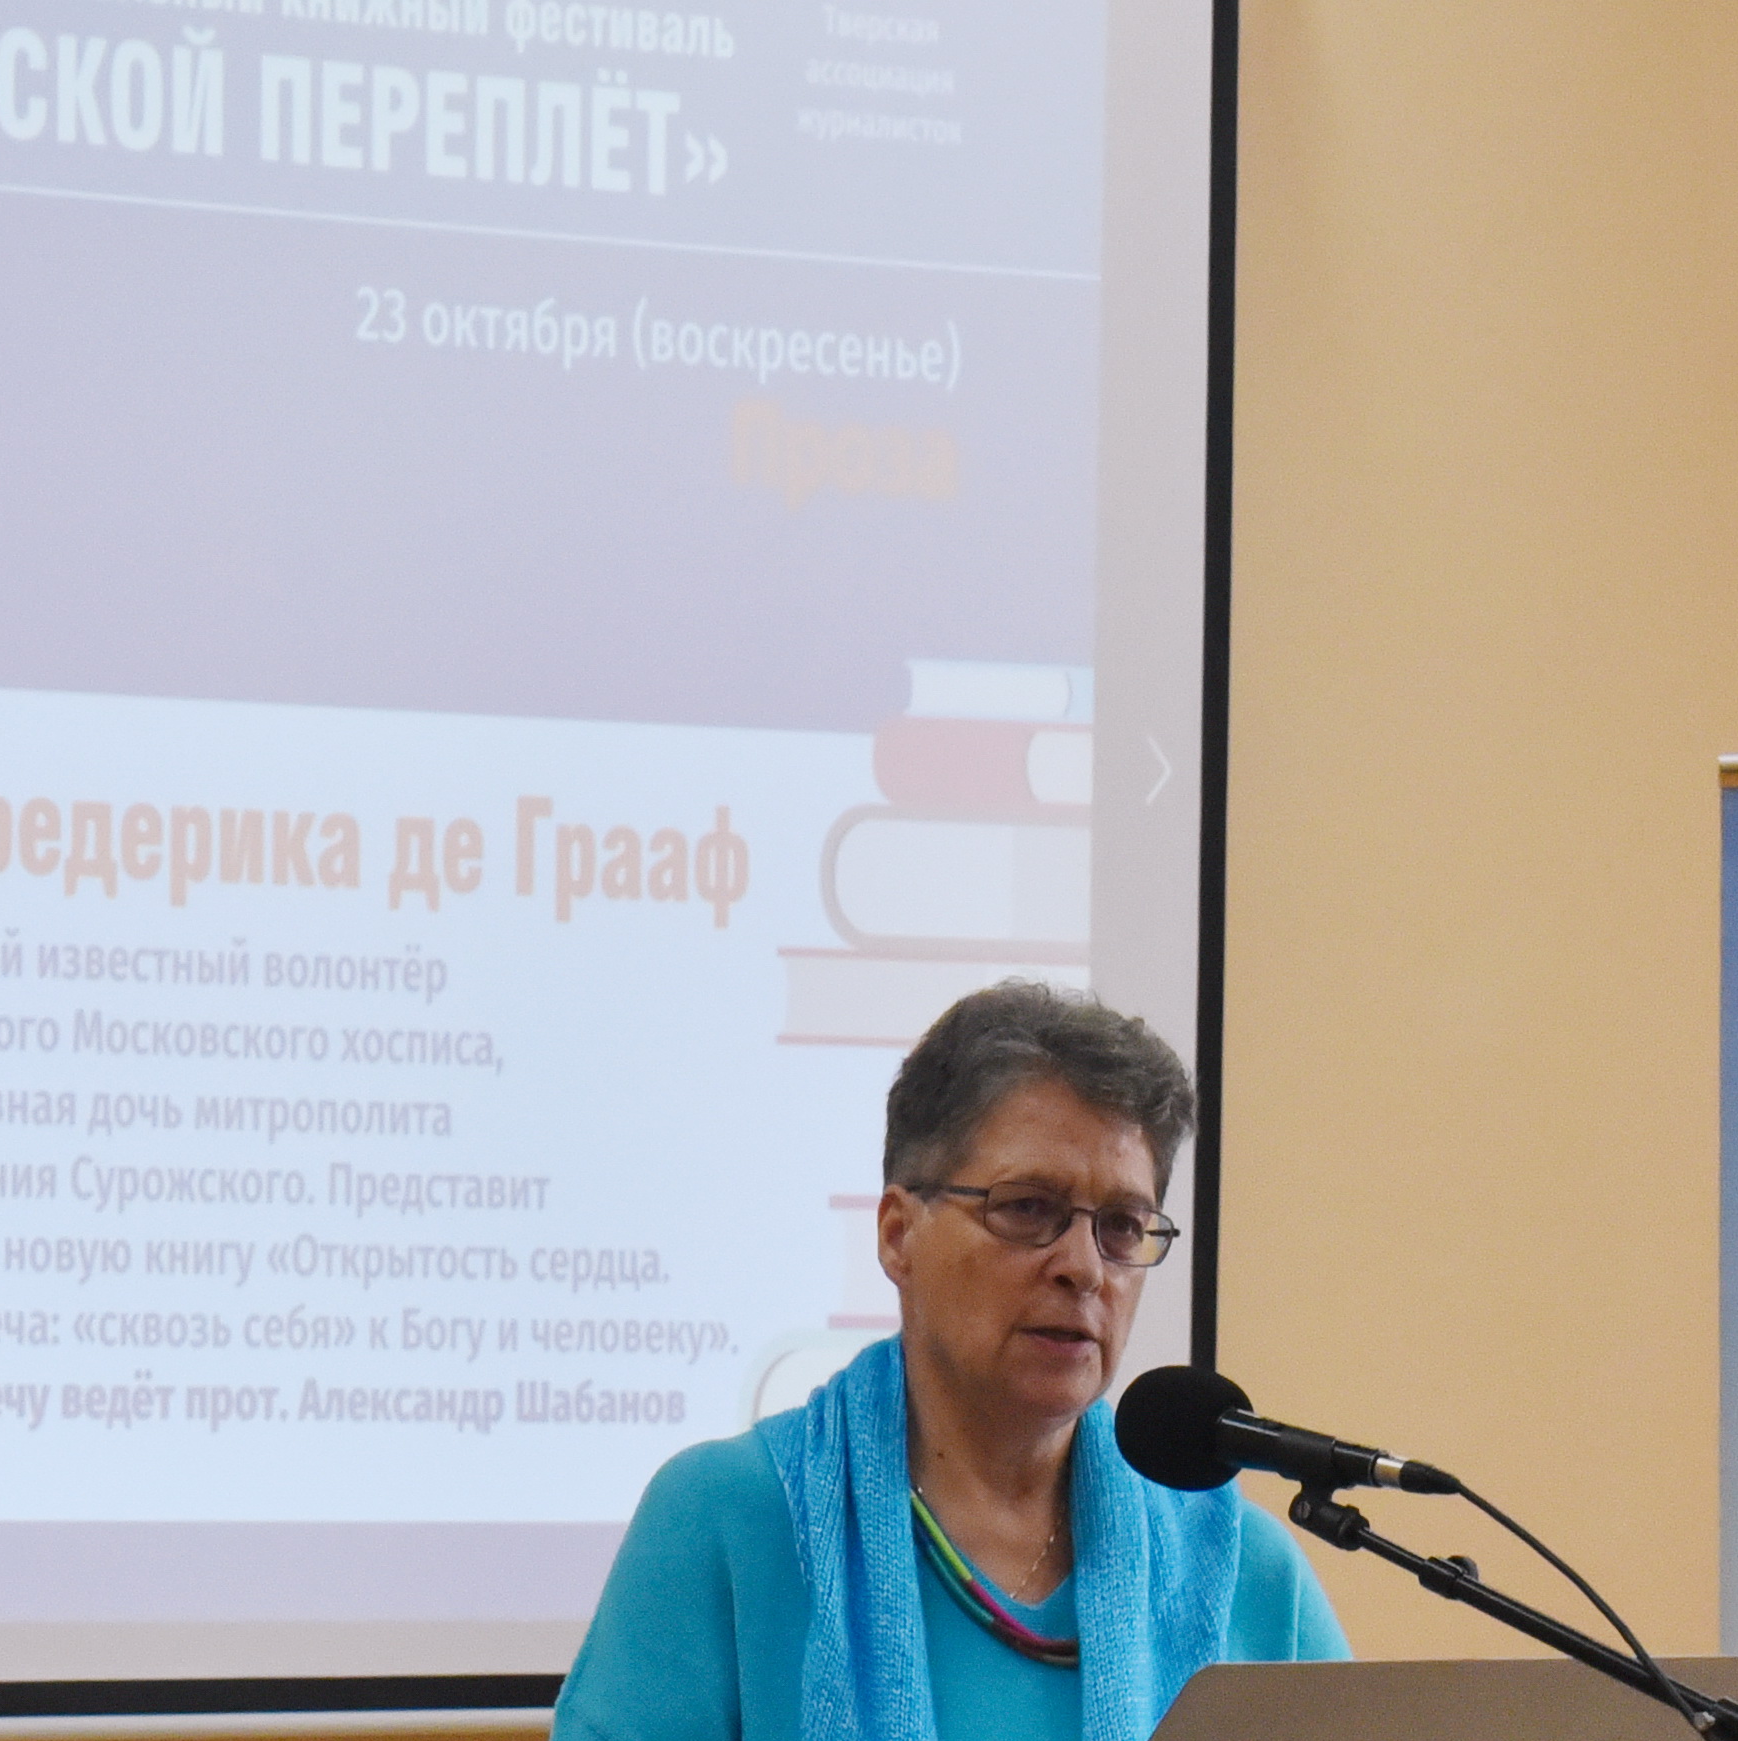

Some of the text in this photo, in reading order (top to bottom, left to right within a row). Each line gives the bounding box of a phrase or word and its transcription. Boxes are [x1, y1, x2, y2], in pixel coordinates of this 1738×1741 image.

[506, 1, 735, 59] фестиваль
[823, 4, 940, 45] Тверская
[261, 55, 727, 195] ПЕРЕПЛЁТ»
[356, 286, 961, 392] 23 октября (воскресенье)
[729, 396, 960, 511] Проза
[388, 816, 484, 911] де
[515, 795, 749, 929] Грааф
[37, 938, 250, 986] известный
[264, 945, 448, 1004] волонтёр
[73, 1009, 330, 1062] Московского
[341, 1028, 504, 1074] хосписа,
[87, 1092, 183, 1136] дочь
[194, 1096, 452, 1144] митрополита
[70, 1154, 315, 1213] Сурожского.
[329, 1162, 550, 1218] Представит
[4, 1237, 132, 1285] новую
[145, 1241, 255, 1287] книгу
[267, 1233, 518, 1290] «Открытость
[529, 1247, 670, 1294] сердца.
[73, 1312, 232, 1349] «сквозь
[243, 1304, 356, 1349] себя»
[369, 1317, 389, 1349] к
[401, 1307, 486, 1363] Богу
[498, 1319, 518, 1351] и
[531, 1319, 738, 1365] человеку».
[61, 1370, 175, 1428] ведёт
[186, 1386, 288, 1432] прот.
[298, 1378, 505, 1434] Александр
[516, 1379, 686, 1424] Шабанов
